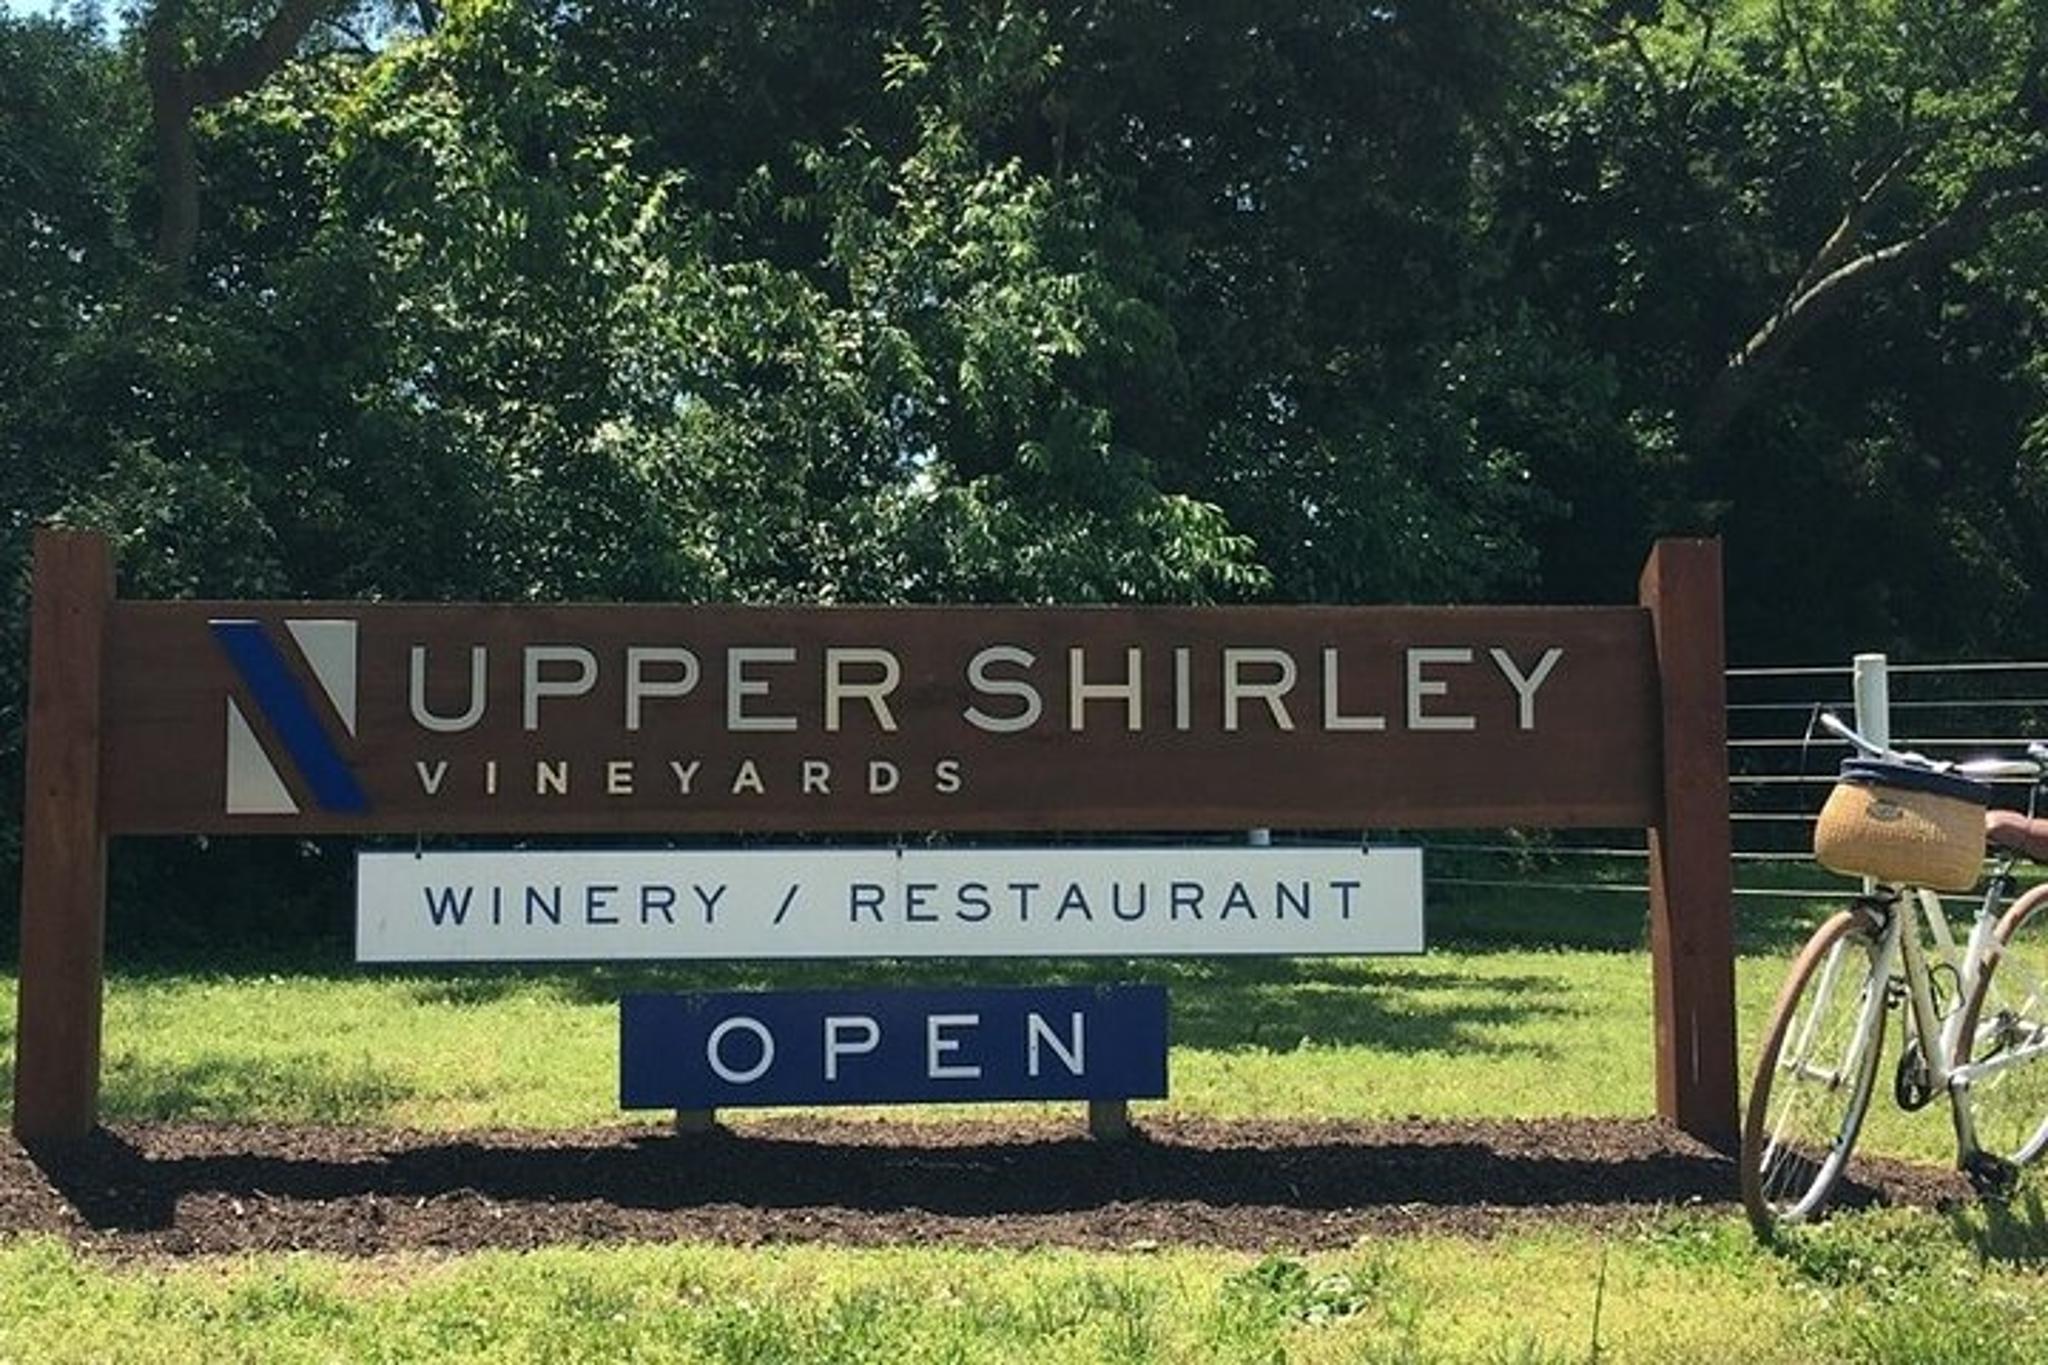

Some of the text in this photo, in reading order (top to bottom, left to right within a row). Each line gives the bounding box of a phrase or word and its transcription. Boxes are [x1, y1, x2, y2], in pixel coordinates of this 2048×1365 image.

[410, 646, 1563, 732] UPPER SHIRLEY
[417, 761, 963, 794] VINEYARDS
[424, 880, 1361, 926] WINERY / RESTAURANT
[707, 1012, 1085, 1082] OPEN
